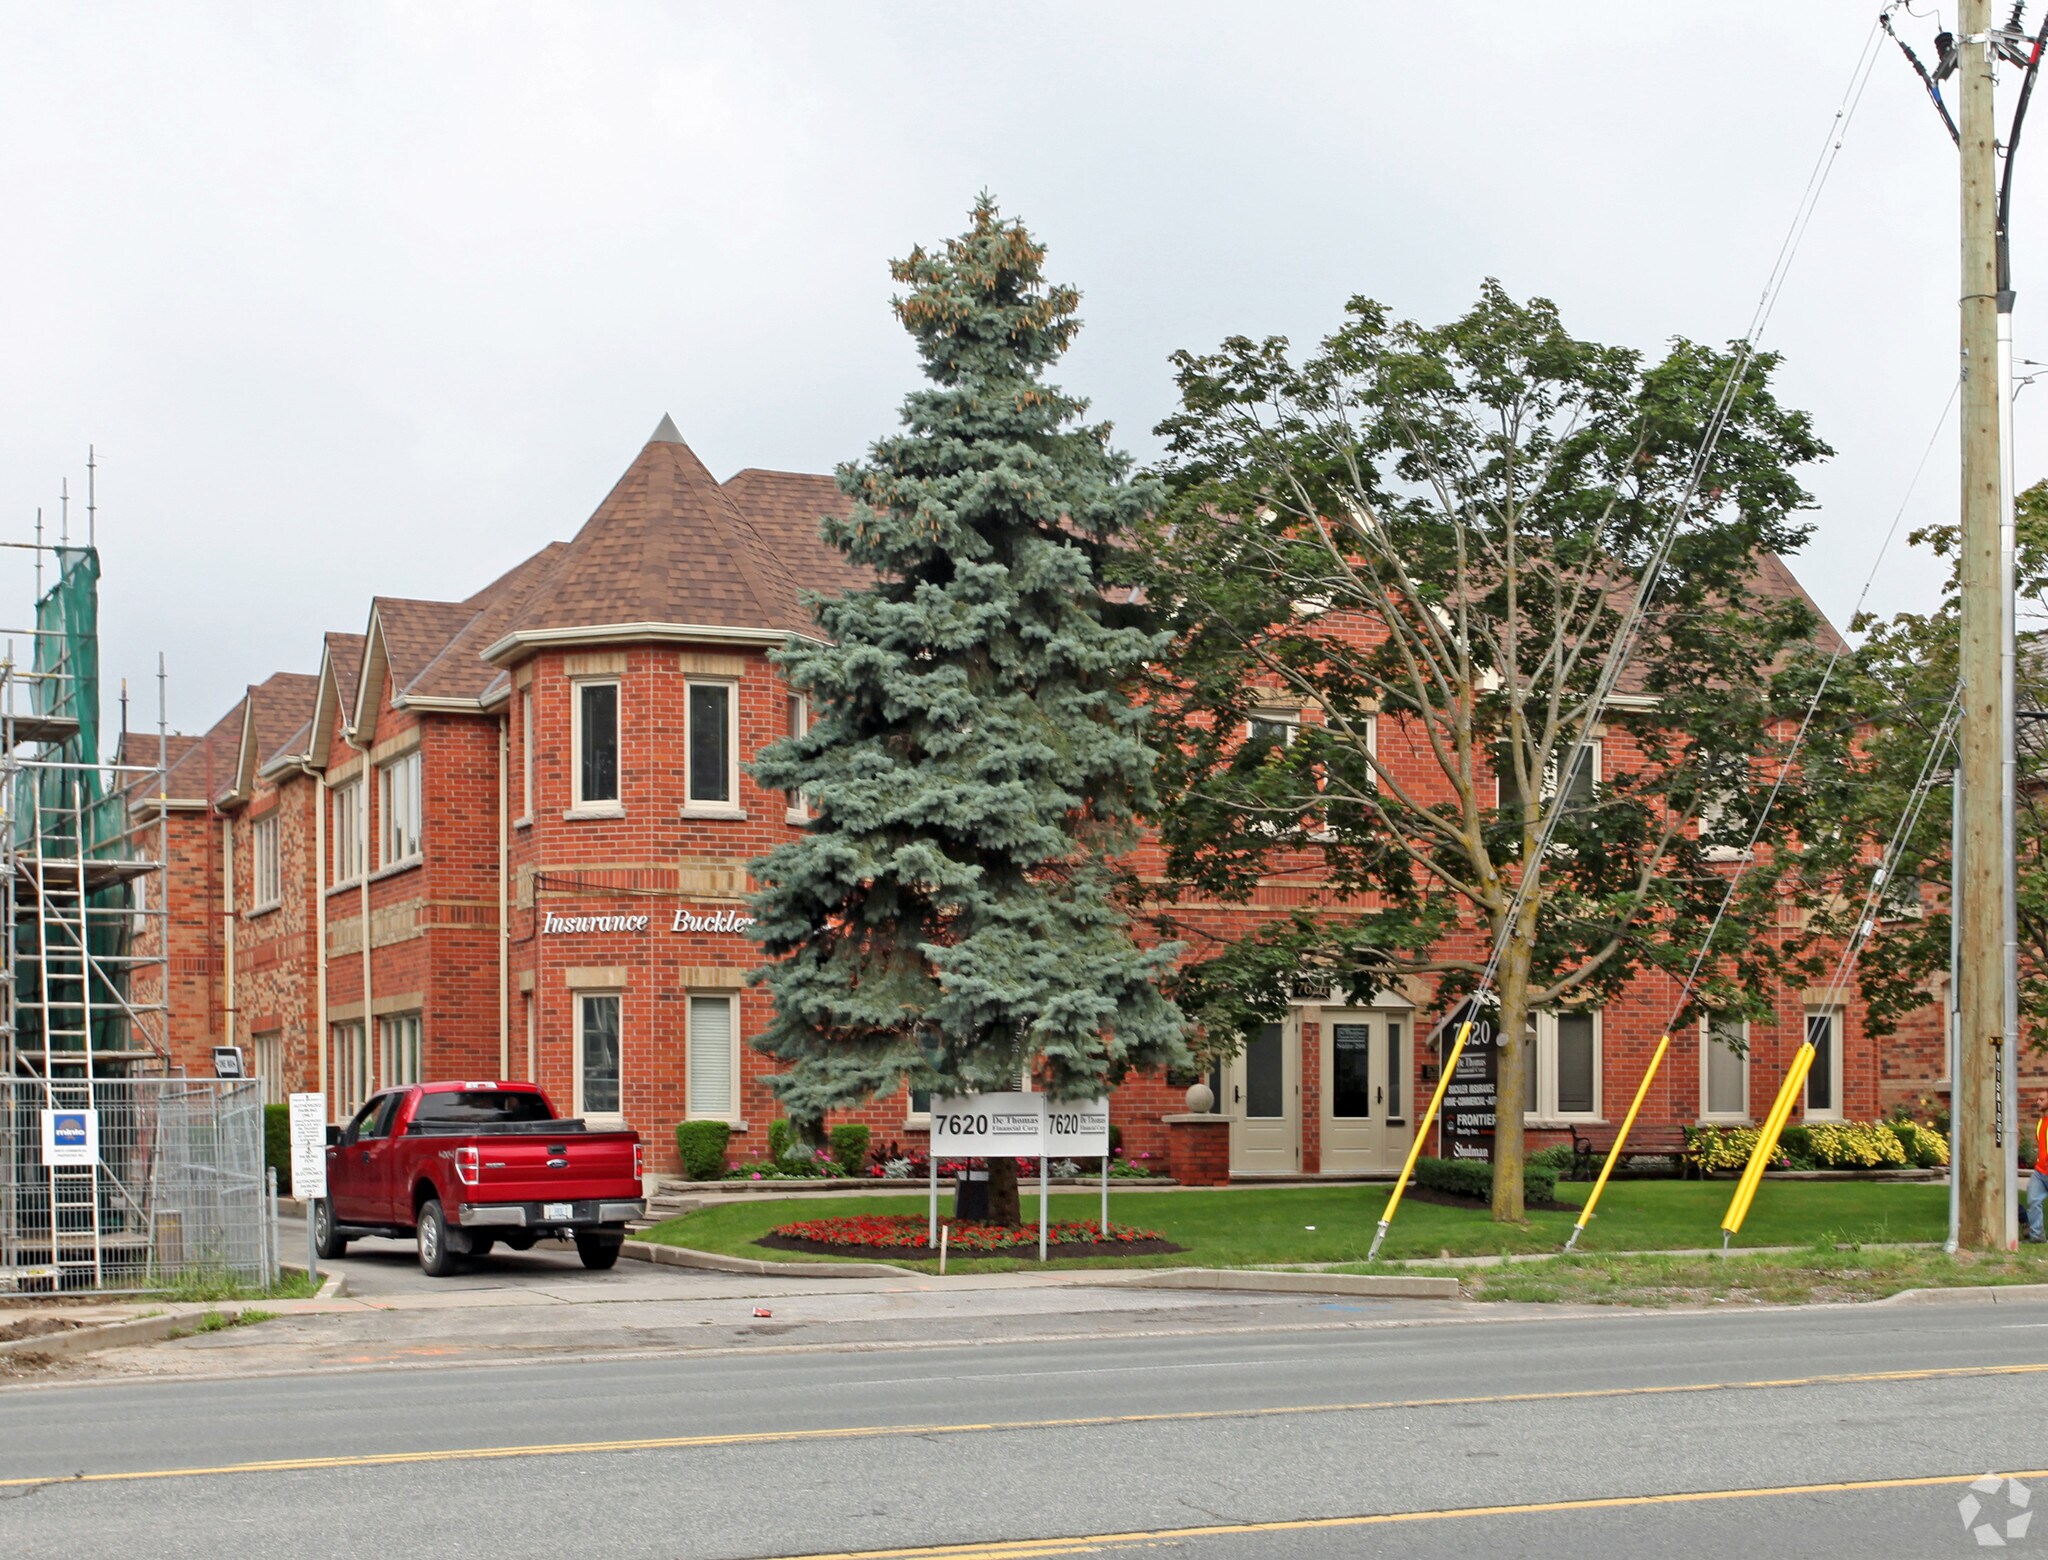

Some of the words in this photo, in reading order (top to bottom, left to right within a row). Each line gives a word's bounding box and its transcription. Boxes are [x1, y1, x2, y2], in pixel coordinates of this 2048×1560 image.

[543, 911, 648, 934] Insurance
[935, 1114, 988, 1135] 7620
[992, 1116, 1004, 1124] De
[1007, 1116, 1039, 1124] Thomas
[1048, 1114, 1079, 1135] 7620
